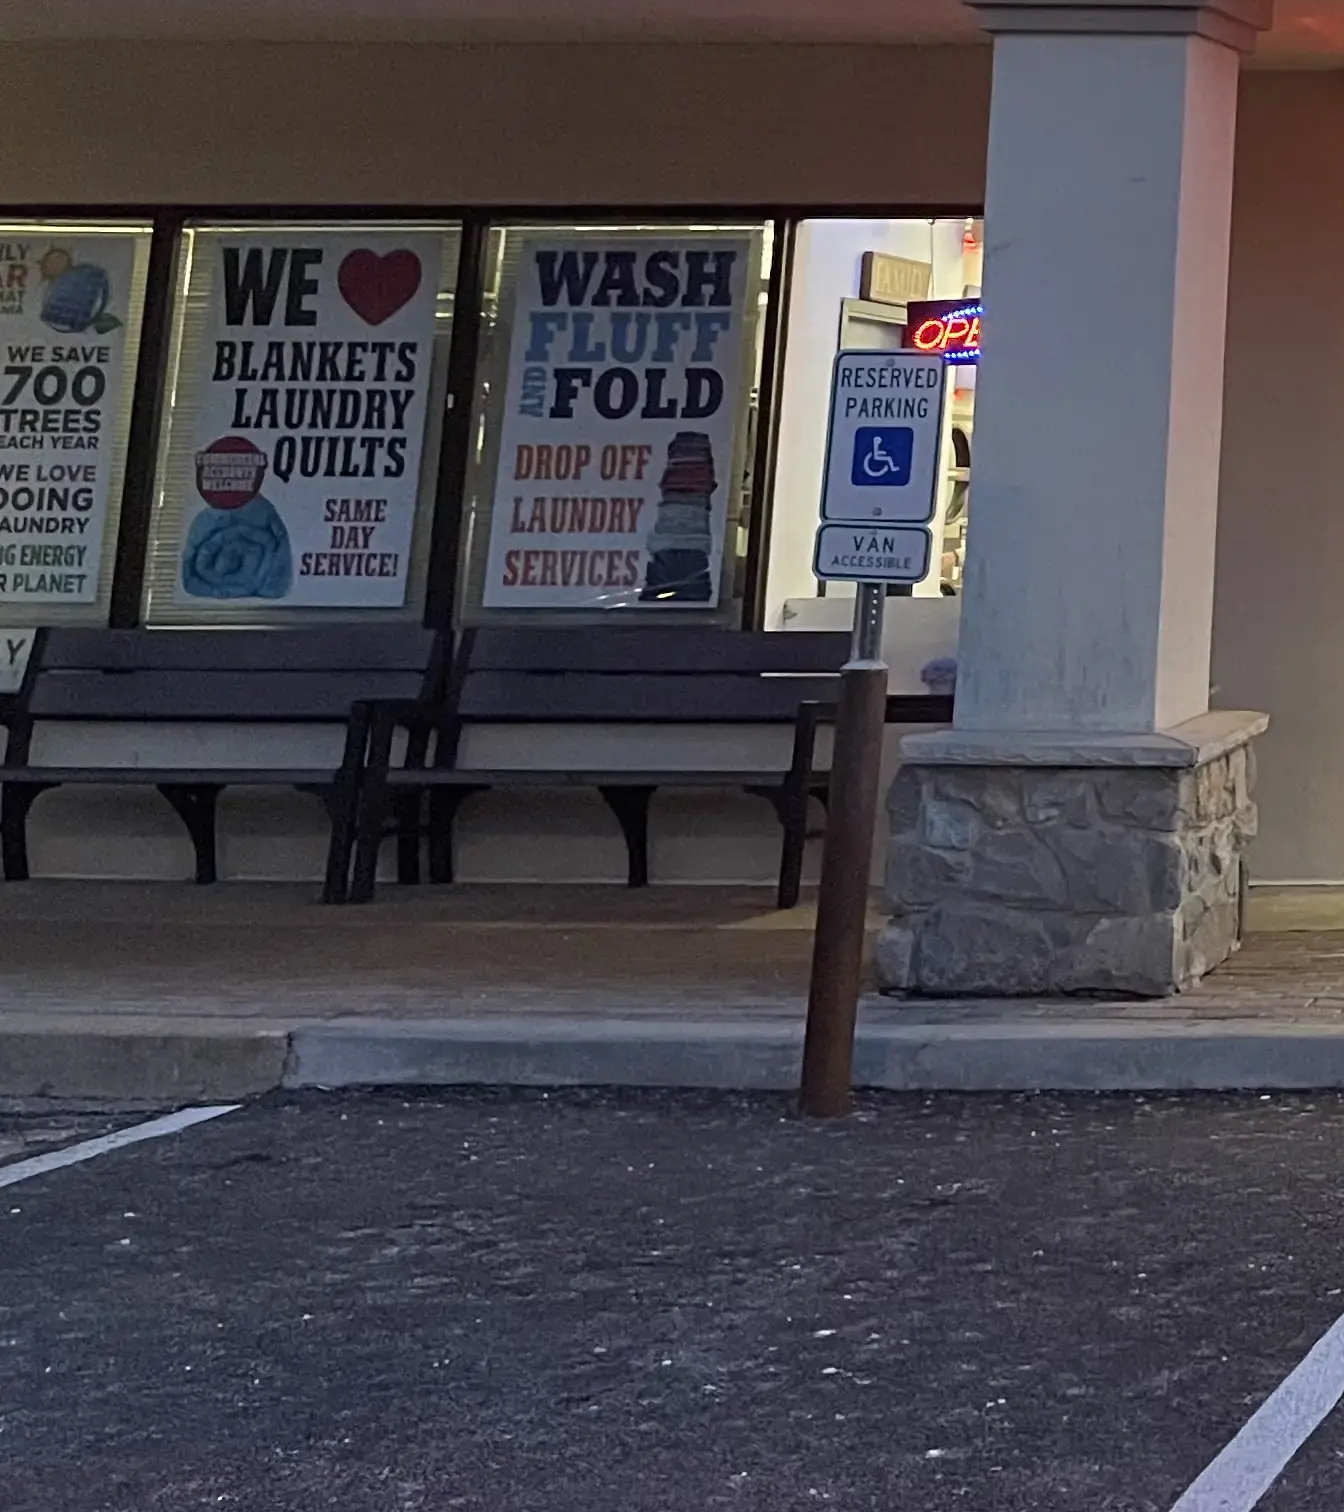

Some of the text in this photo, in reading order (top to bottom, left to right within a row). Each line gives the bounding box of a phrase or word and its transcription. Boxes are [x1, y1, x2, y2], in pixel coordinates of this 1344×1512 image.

[223, 247, 323, 326] WE
[535, 250, 737, 307] WASH
[525, 312, 731, 363] FLUFF
[7, 346, 110, 363] WE SAVE
[212, 341, 417, 382] BLANKETS
[2, 365, 106, 406] 700
[840, 367, 938, 388] RESERVED
[518, 366, 547, 418] AND
[549, 367, 724, 419] FOLD
[231, 388, 415, 429] LAUNDRY
[845, 397, 929, 419] PARKING
[0, 409, 102, 433] TREES
[51, 435, 99, 449] YEAR
[273, 436, 407, 483] QUILTS
[514, 444, 652, 481] DROP OFF
[36, 464, 97, 482] LOVE
[324, 499, 388, 522] SAME
[510, 496, 645, 534] LAUNDRY
[0, 516, 91, 534] AUNDRY
[330, 525, 376, 549] DAY
[20, 544, 87, 566] ENERGY
[853, 536, 895, 552] VAN
[300, 552, 399, 577] SERVICE!
[503, 550, 640, 586] SERVICES
[831, 555, 912, 569] ACCESSIBLE
[13, 574, 87, 593] PLANET
